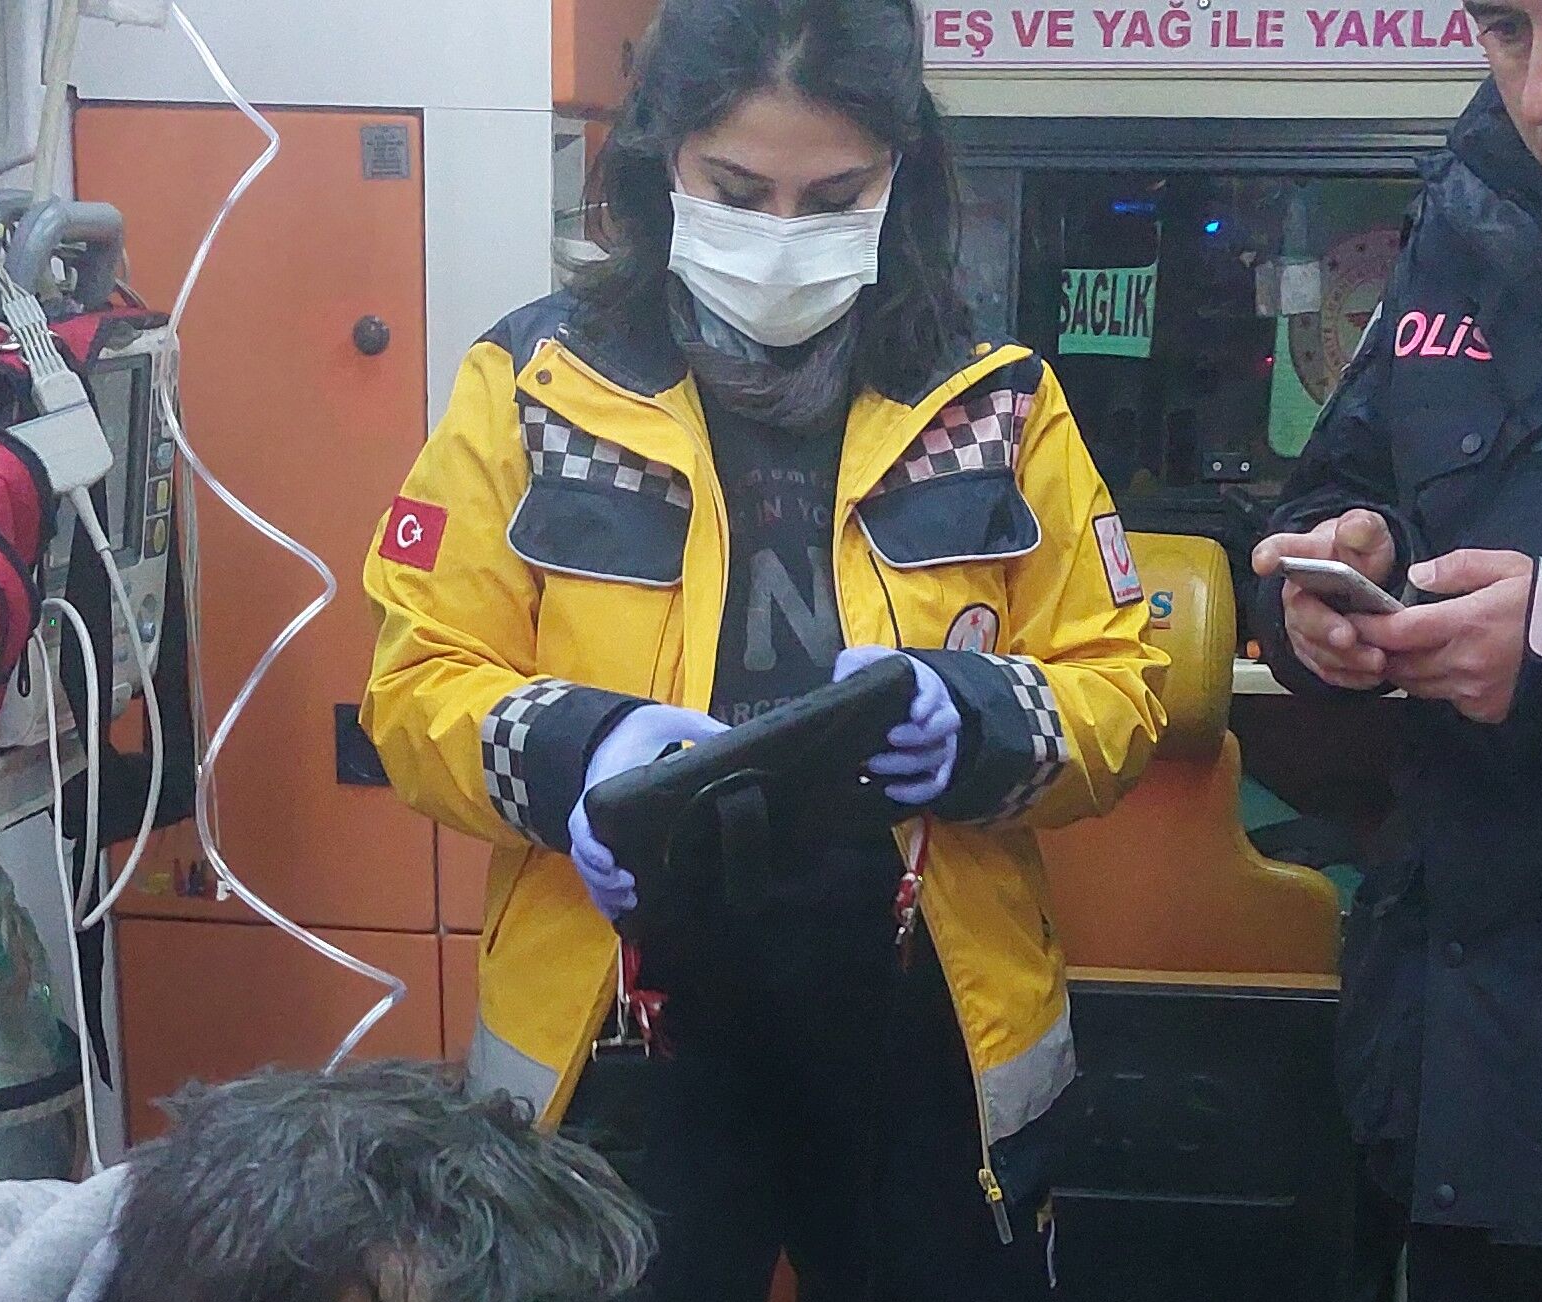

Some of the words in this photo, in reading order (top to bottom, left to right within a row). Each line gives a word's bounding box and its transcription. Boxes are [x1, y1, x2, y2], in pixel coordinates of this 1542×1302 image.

[933, 9, 994, 57] EŞ
[1011, 9, 1075, 48] VE
[1306, 9, 1474, 48] YAKLA
